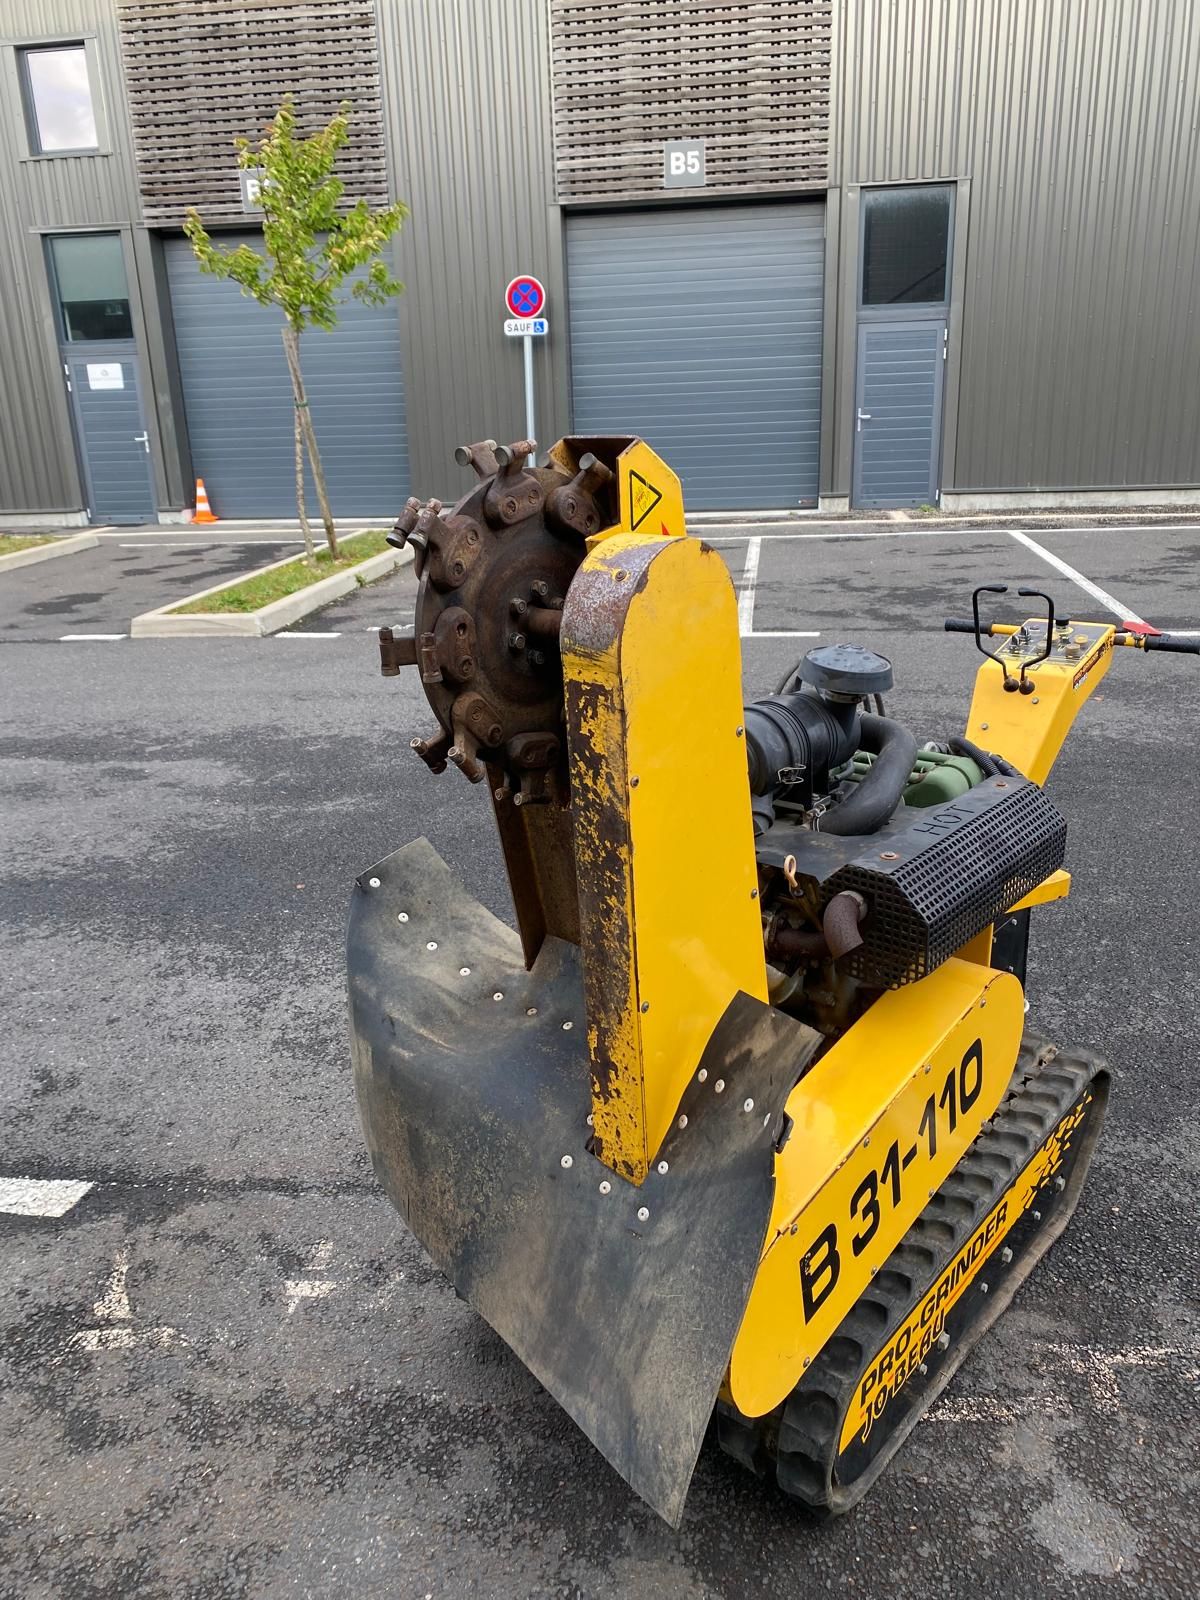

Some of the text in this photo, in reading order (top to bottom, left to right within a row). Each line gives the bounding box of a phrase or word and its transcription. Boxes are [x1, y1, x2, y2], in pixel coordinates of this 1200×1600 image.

[670, 150, 700, 175] B5
[246, 178, 271, 202] B
[506, 322, 533, 333] SAUF
[912, 803, 976, 836] HOT
[799, 1037, 983, 1326] B 31-110
[860, 1200, 1009, 1409] PRO-GRINDER
